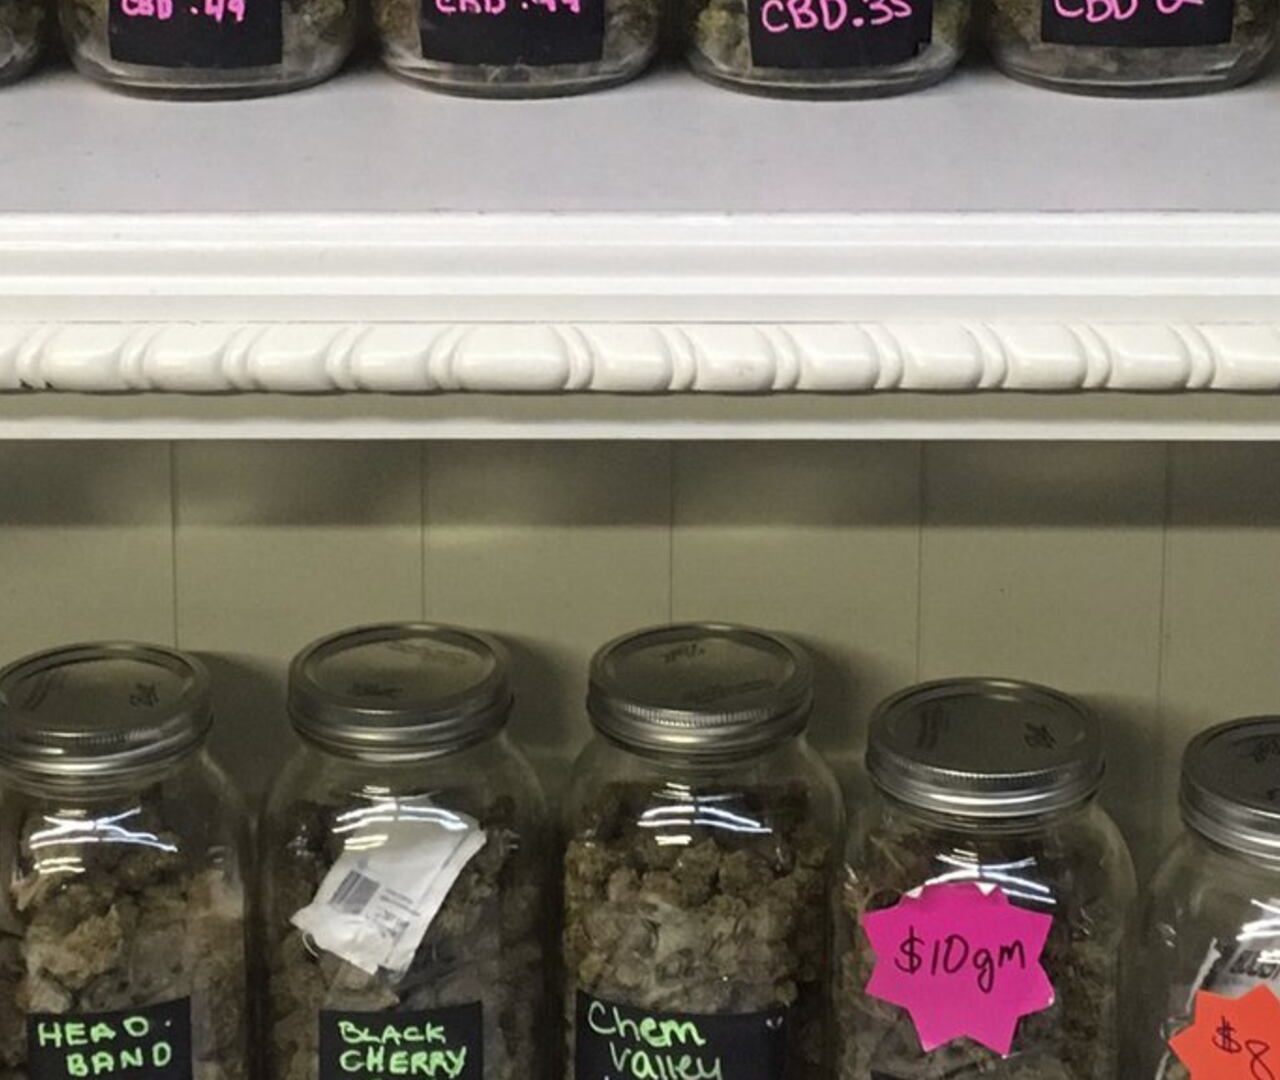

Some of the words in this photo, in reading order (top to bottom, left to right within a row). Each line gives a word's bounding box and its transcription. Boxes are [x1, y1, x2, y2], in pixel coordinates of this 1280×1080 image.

[893, 926, 1026, 994] $10gm
[37, 1015, 150, 1048] HEAD
[338, 1021, 447, 1046] BLACK
[588, 1000, 706, 1047] Chem
[66, 1042, 172, 1077] BAND
[339, 1046, 467, 1079] CHERRY
[609, 1041, 723, 1080] Valley
